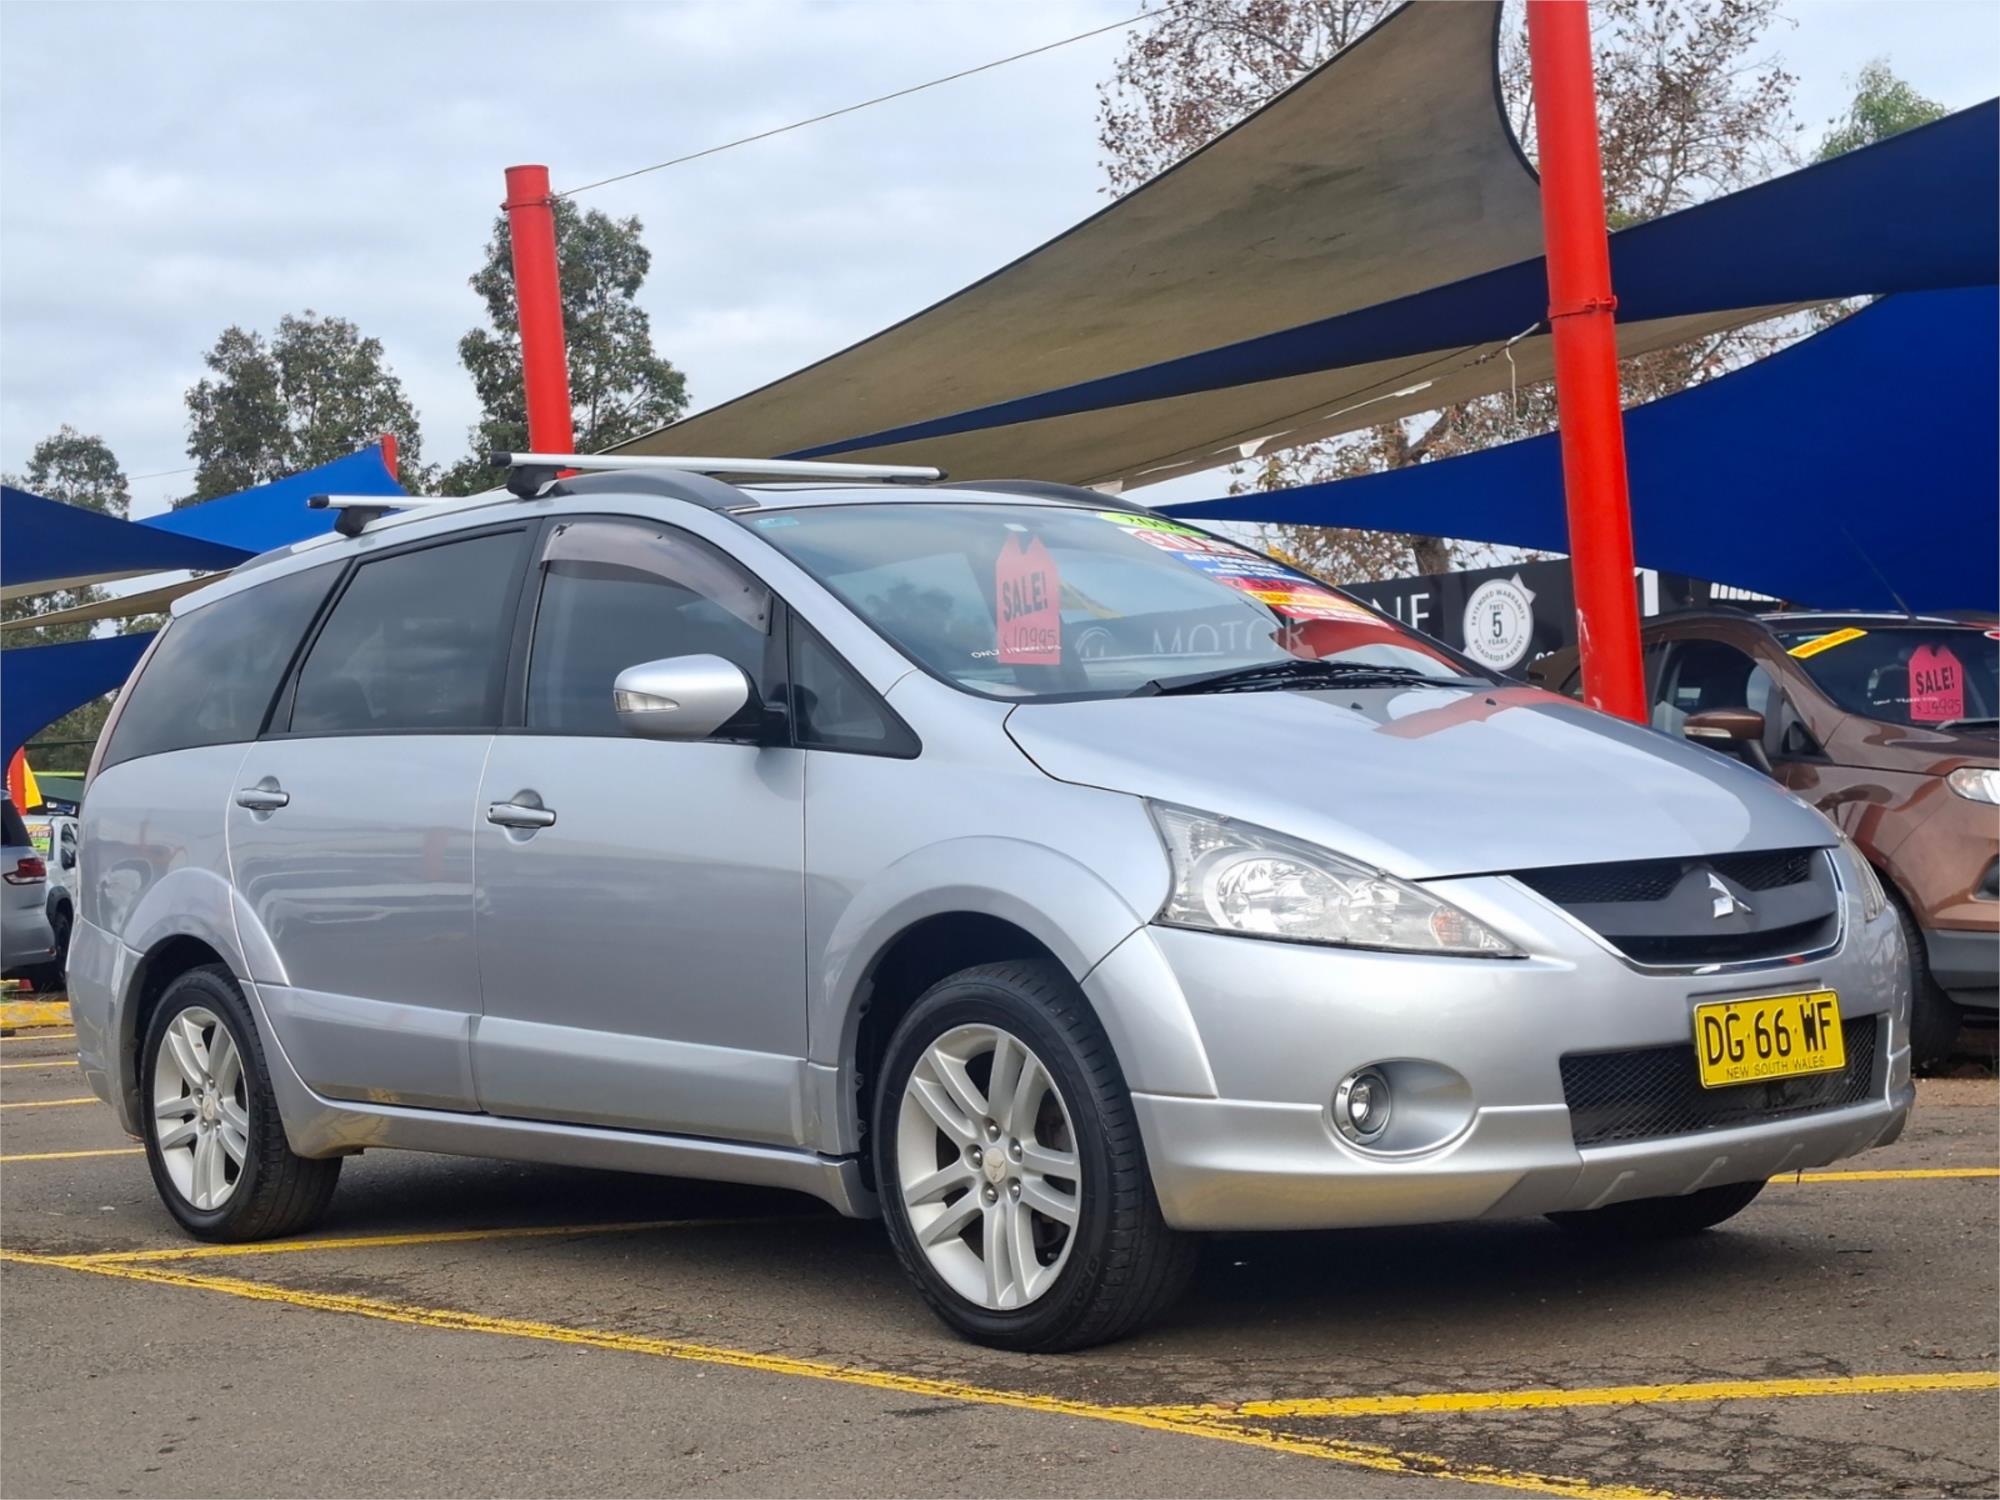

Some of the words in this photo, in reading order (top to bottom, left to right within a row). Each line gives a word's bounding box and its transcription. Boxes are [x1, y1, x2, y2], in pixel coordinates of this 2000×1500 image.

[1003, 571, 1048, 623] SALE!
[1471, 590, 1495, 626] EXTENDED
[1496, 589, 1525, 620] WARRANTY
[1489, 603, 1505, 611] FREE
[1493, 611, 1503, 638] 5
[1473, 637, 1504, 662] ROADSIDE
[1488, 638, 1508, 646] YEARS
[1915, 666, 1955, 695] SALE!
[1726, 1066, 1750, 1080] NEW
[1754, 1060, 1789, 1076] SOUTH
[1793, 1055, 1826, 1070] WALES
